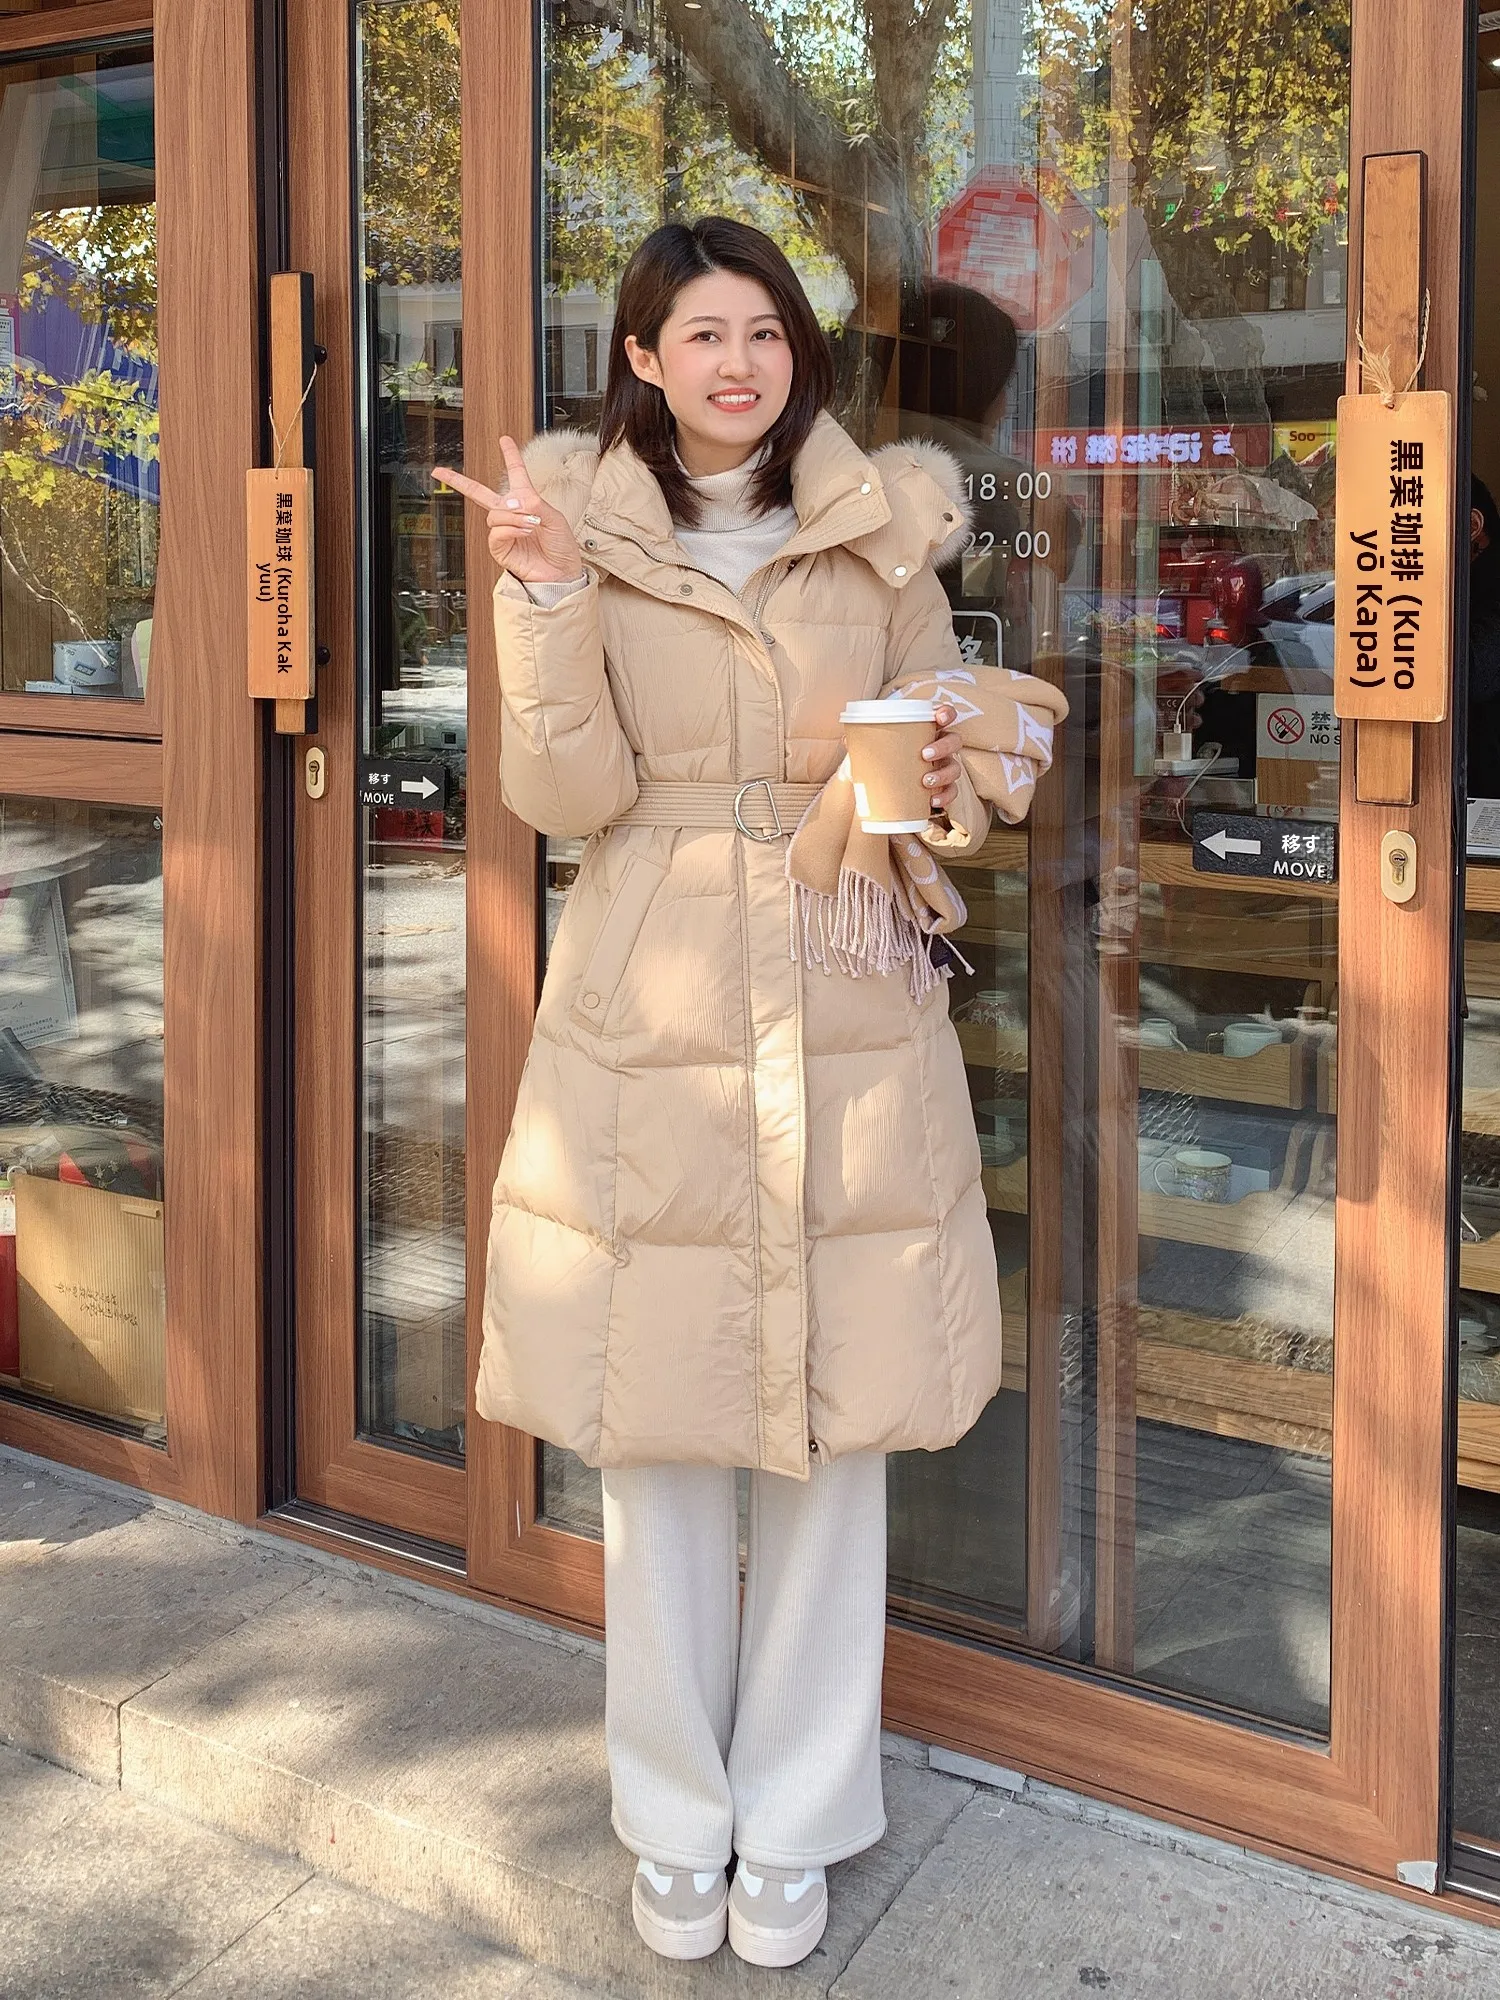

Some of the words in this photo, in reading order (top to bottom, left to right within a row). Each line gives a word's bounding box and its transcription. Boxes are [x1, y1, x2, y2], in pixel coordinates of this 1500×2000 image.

[964, 471, 1052, 501] 18:00
[962, 530, 1051, 559] 22:00
[1350, 529, 1385, 572] yō
[255, 562, 275, 602] yuu)
[273, 567, 293, 637] (Kuroha
[1350, 584, 1386, 689] Kapa)
[1386, 594, 1424, 690] (Kuro
[277, 641, 293, 675] Kak
[1311, 711, 1341, 731] 禁
[1309, 734, 1330, 745] NO
[368, 772, 391, 785] 移す
[363, 791, 395, 805] MOVE
[1281, 833, 1321, 854] 移す
[1273, 860, 1328, 879] MOVE
